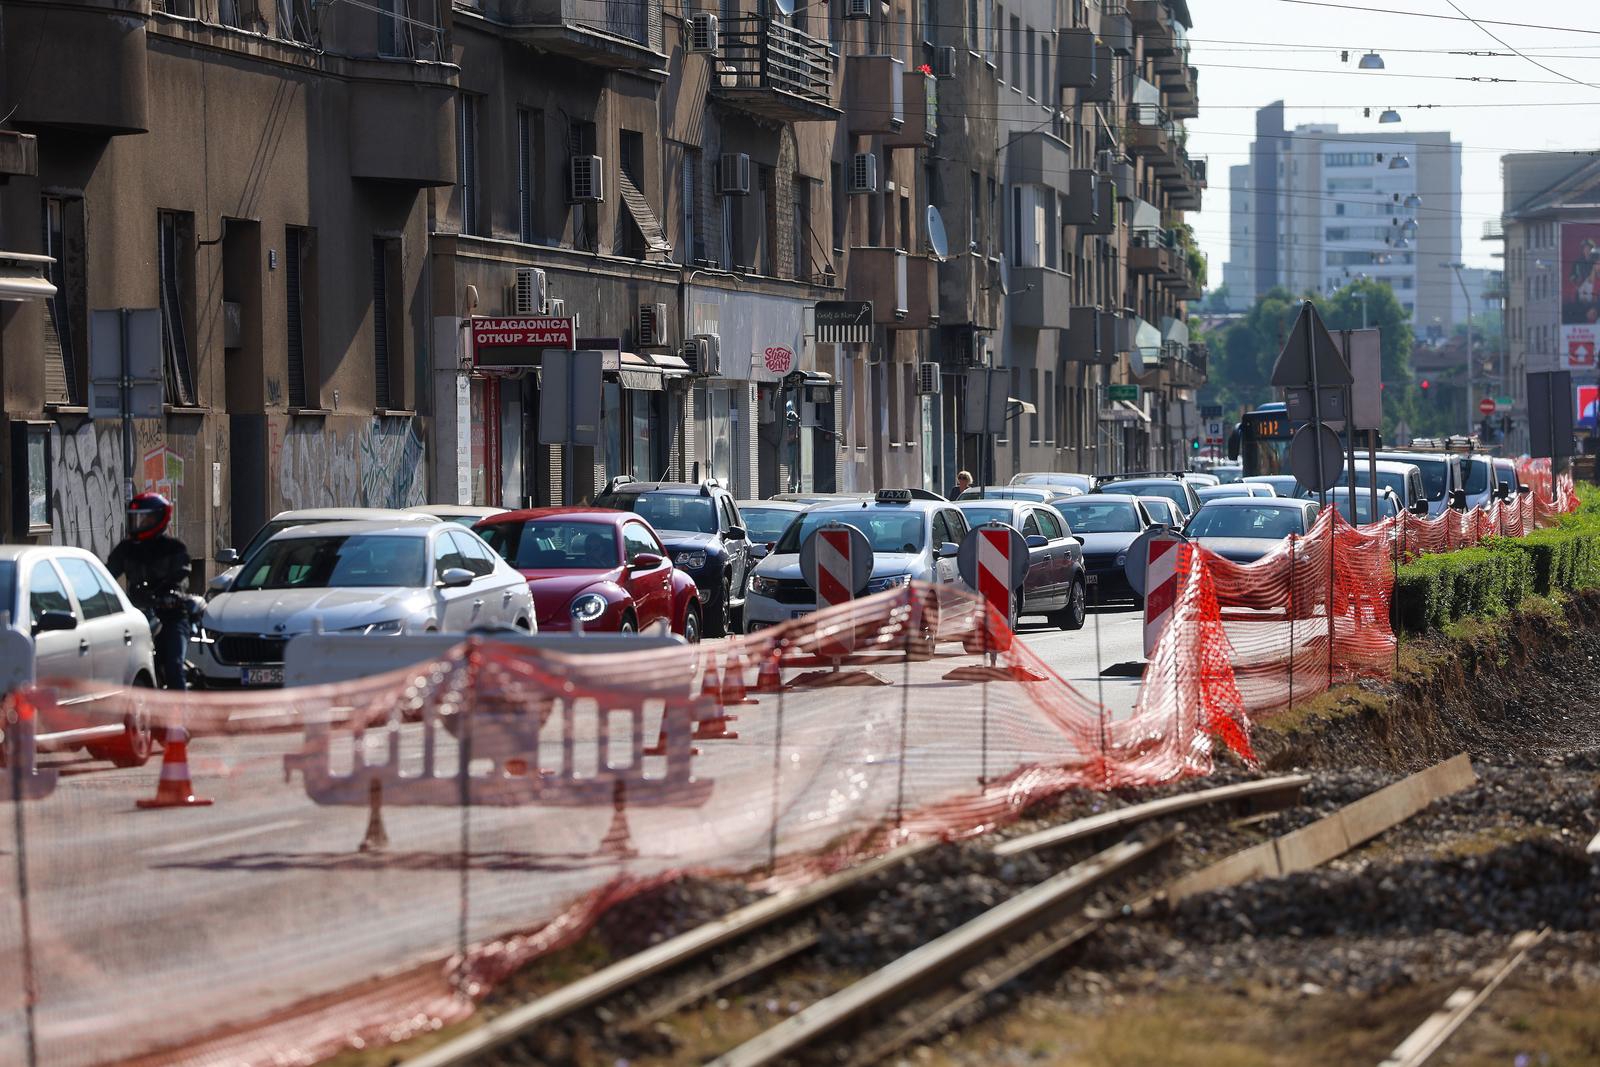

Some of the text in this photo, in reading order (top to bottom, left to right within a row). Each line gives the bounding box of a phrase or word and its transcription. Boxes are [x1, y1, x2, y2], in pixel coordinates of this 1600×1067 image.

[475, 320, 569, 330] ZALAGAONICA
[477, 333, 568, 343] OTKUP ZLATA
[881, 490, 905, 499] TAXI
[250, 671, 263, 681] ZG
